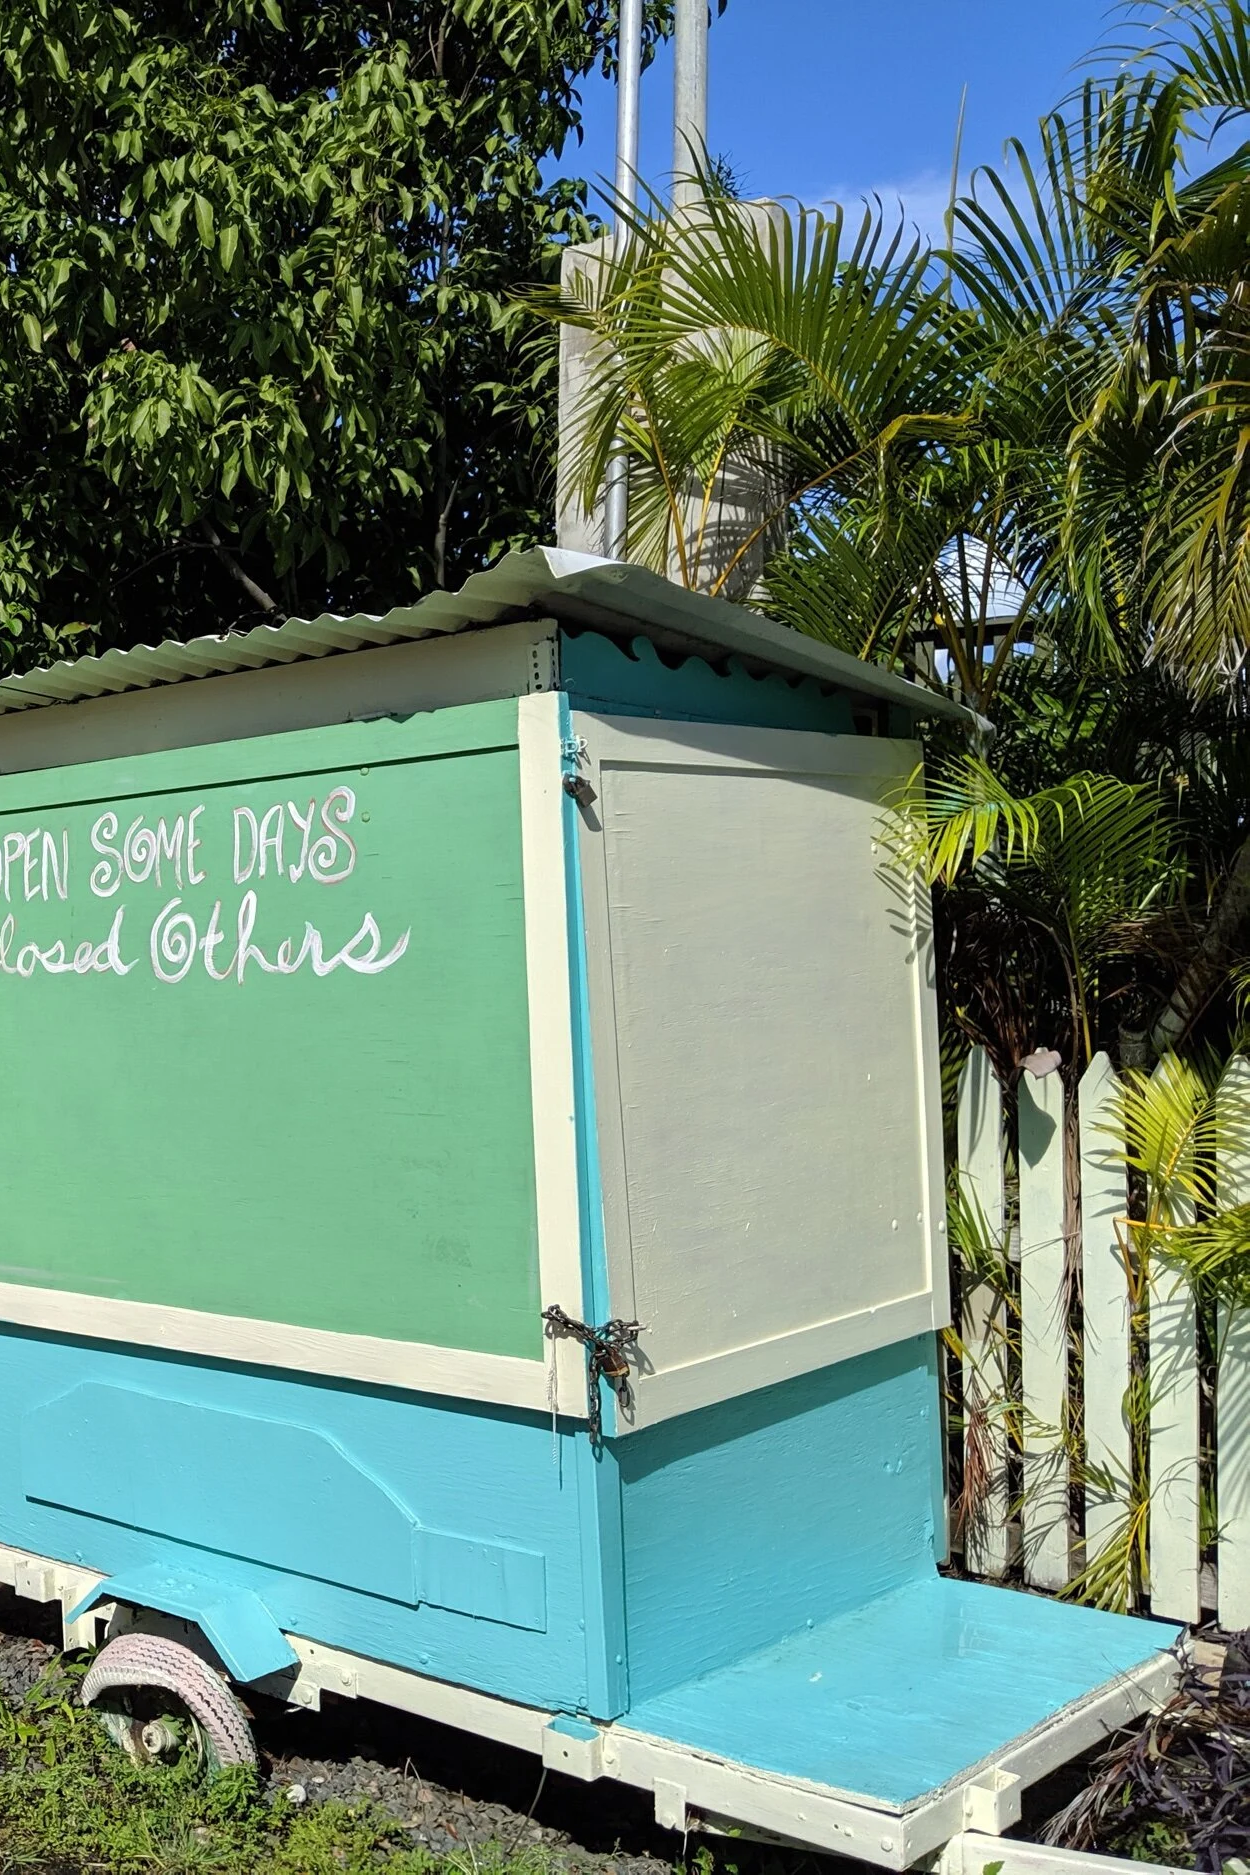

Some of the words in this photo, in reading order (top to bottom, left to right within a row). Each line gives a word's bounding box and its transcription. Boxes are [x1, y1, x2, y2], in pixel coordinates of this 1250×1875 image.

[90, 804, 207, 898] SOME
[233, 785, 357, 885] DAYS
[151, 890, 411, 986] Others
